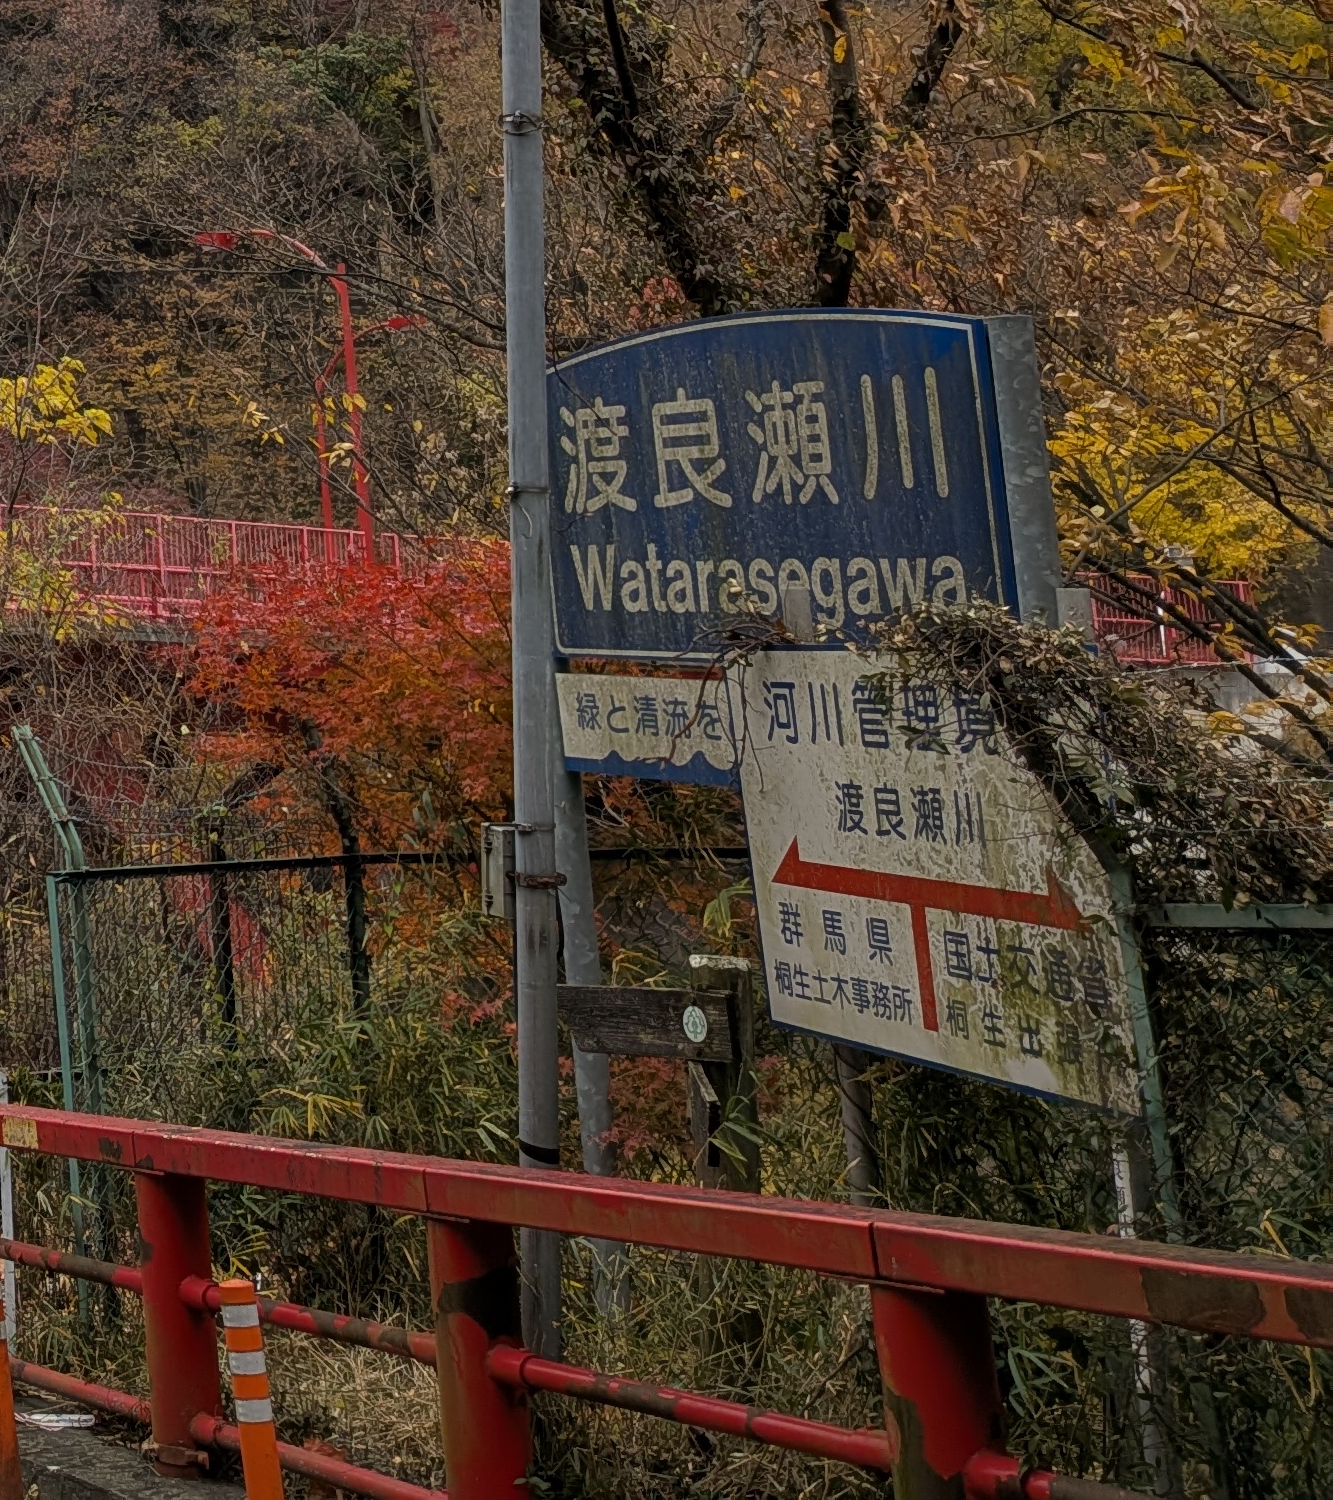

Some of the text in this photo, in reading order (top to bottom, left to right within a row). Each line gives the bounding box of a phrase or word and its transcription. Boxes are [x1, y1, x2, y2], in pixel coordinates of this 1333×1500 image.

[560, 367, 949, 514] 渡良瀬川
[569, 543, 967, 629] Watarasegawa
[575, 691, 723, 741] 緑と清流を
[835, 779, 985, 849] 渡良瀬川
[777, 901, 894, 967] 群馬県
[943, 929, 1111, 1009] 国土交通省
[773, 958, 913, 1026] 桐生土木事務所
[945, 997, 1125, 1080] 桐生出張
